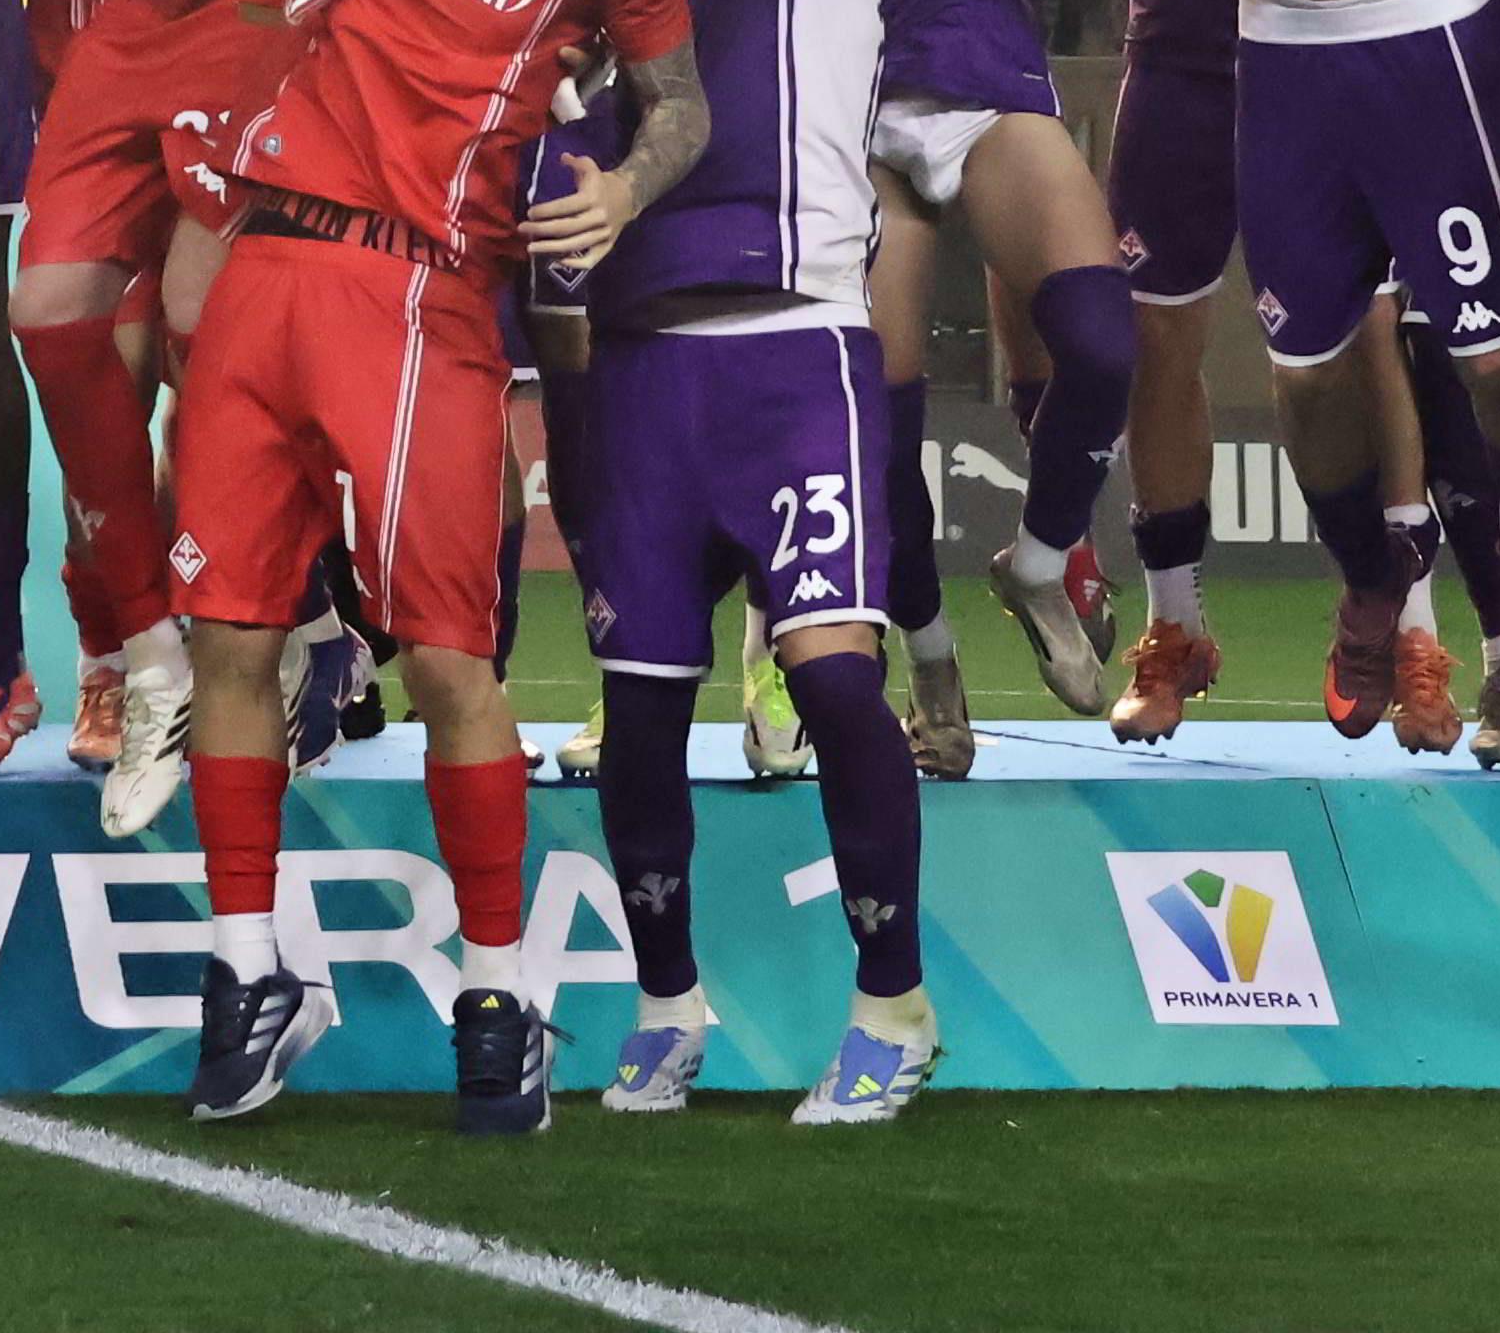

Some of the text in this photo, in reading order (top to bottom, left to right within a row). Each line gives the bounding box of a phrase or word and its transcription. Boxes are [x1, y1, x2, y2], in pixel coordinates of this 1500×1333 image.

[1437, 206, 1492, 286] 9
[771, 474, 850, 572] 23
[1164, 991, 1319, 1009] PRIMAVERA 1
